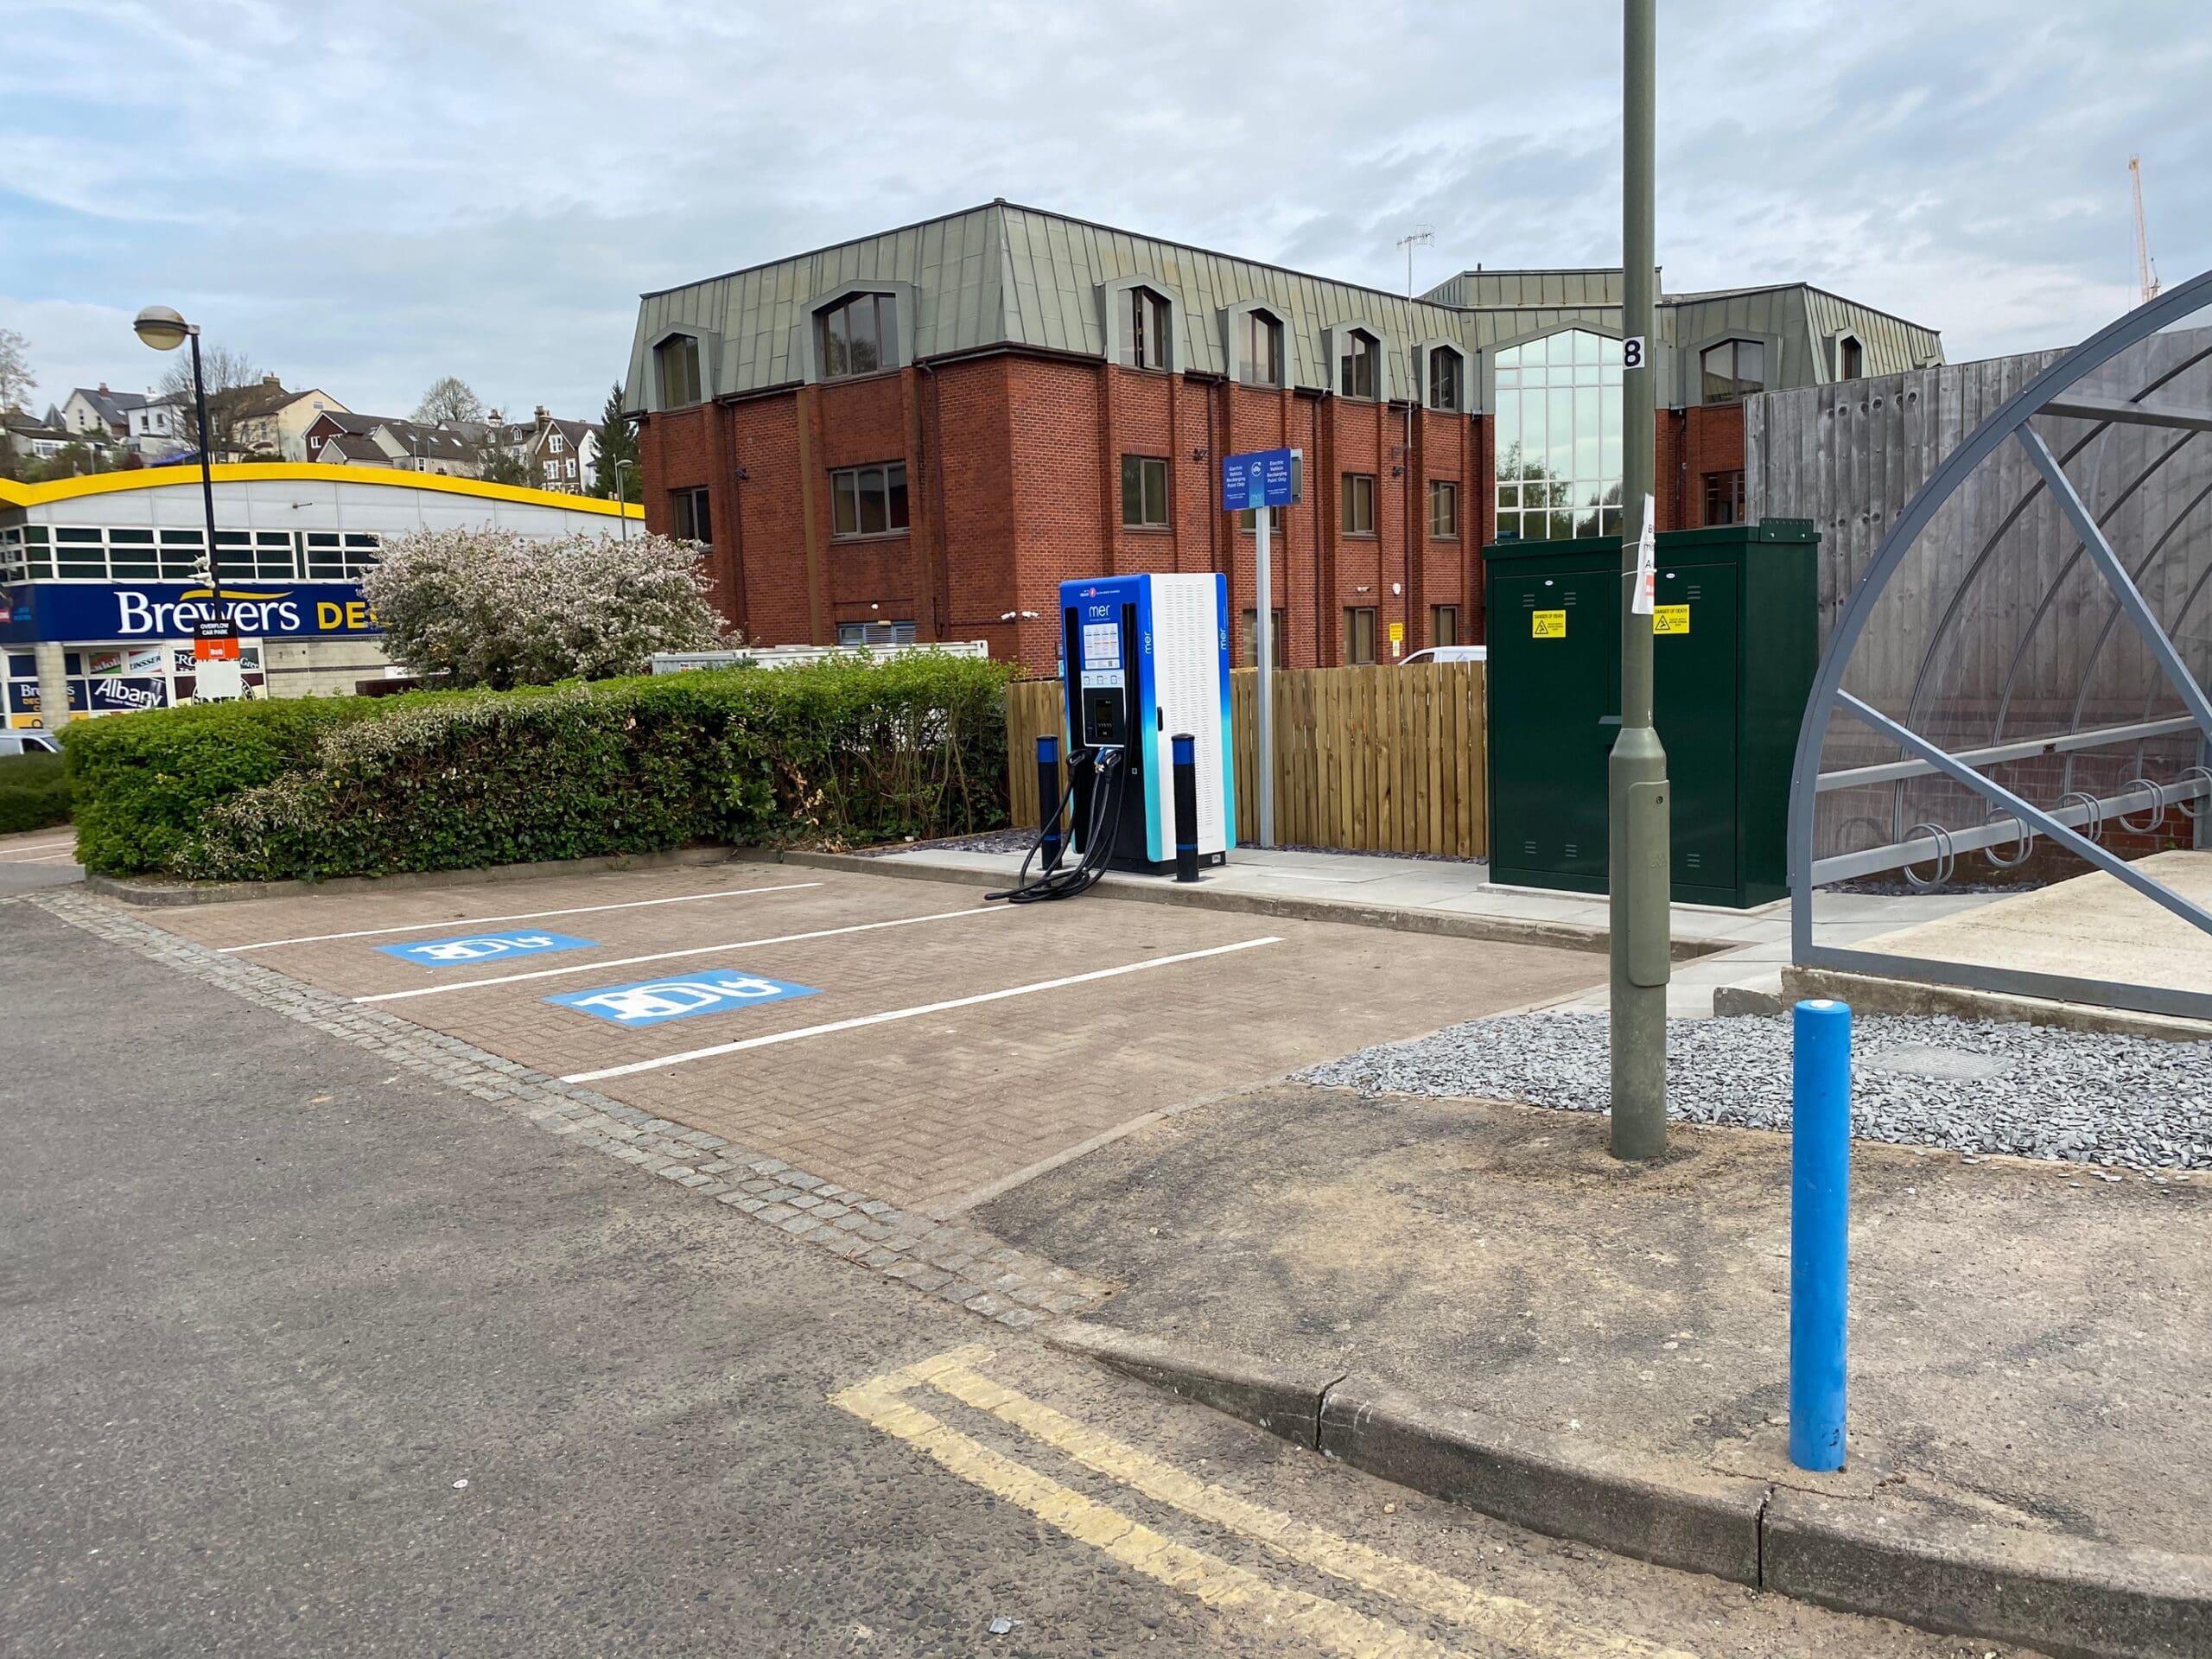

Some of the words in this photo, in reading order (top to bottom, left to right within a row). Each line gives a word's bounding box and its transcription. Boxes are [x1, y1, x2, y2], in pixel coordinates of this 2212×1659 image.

[1624, 340, 1641, 367] 8
[113, 591, 301, 634] Brewers
[1089, 605, 1110, 618] mer
[94, 678, 164, 709] Albany
